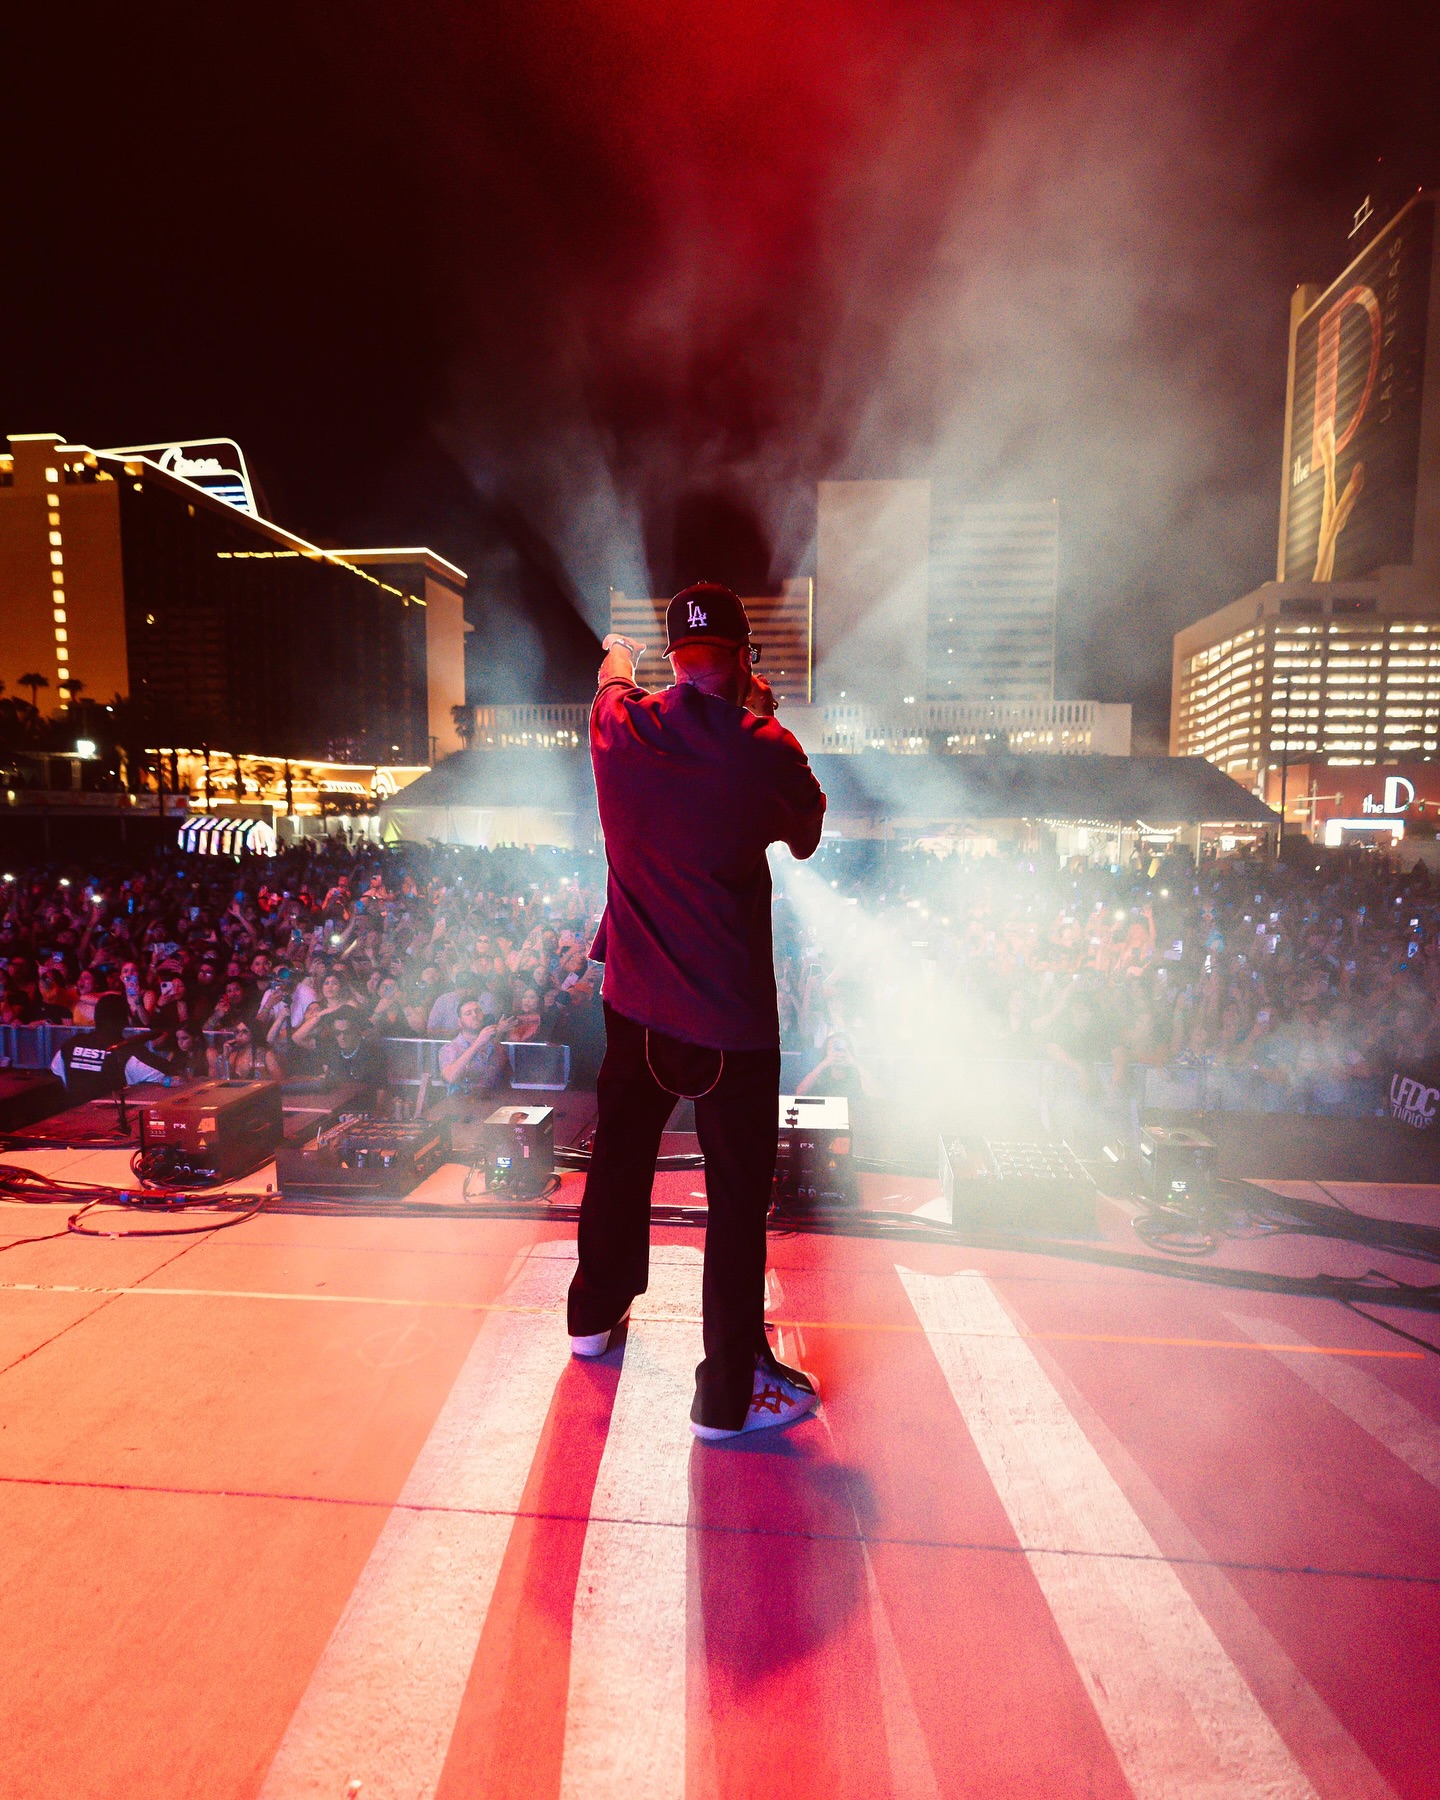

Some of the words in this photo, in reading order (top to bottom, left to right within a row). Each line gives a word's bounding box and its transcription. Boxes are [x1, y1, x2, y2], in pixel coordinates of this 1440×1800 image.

[1293, 454, 1310, 487] the
[1311, 285, 1381, 473] D
[687, 601, 707, 628] LA
